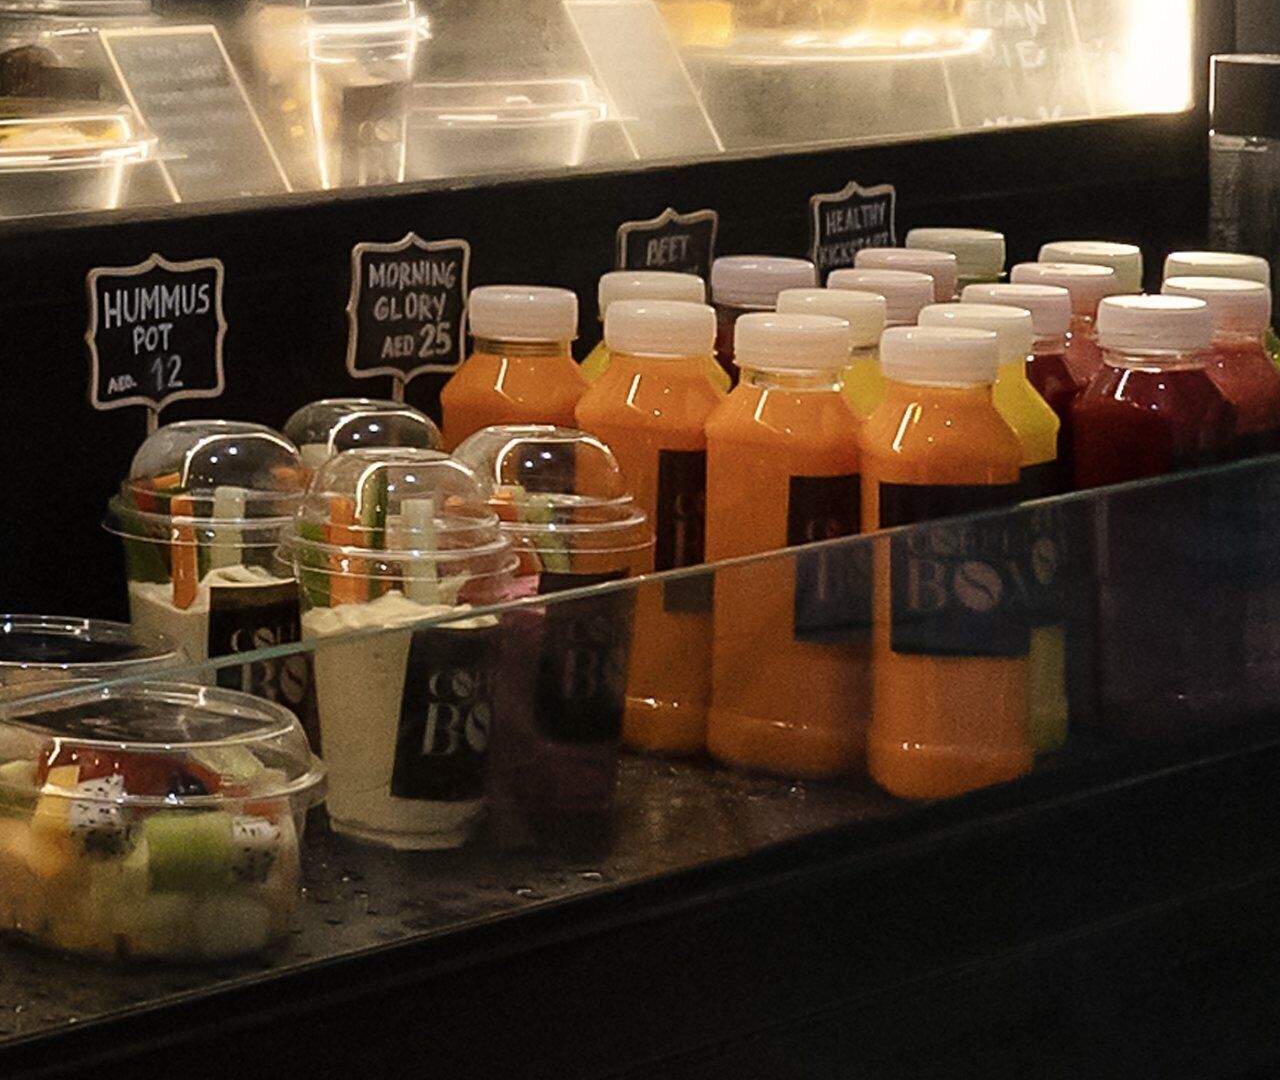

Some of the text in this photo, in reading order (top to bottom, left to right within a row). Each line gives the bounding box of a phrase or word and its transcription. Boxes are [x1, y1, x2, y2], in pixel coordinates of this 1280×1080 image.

[826, 201, 886, 236] HEALTHY
[646, 235, 690, 266] BEET
[368, 261, 456, 290] MORNING
[104, 283, 211, 329] HUMMUS
[373, 292, 448, 322] GLORY
[132, 323, 174, 356] POT
[381, 322, 452, 359] AED 25
[151, 354, 184, 391] 12
